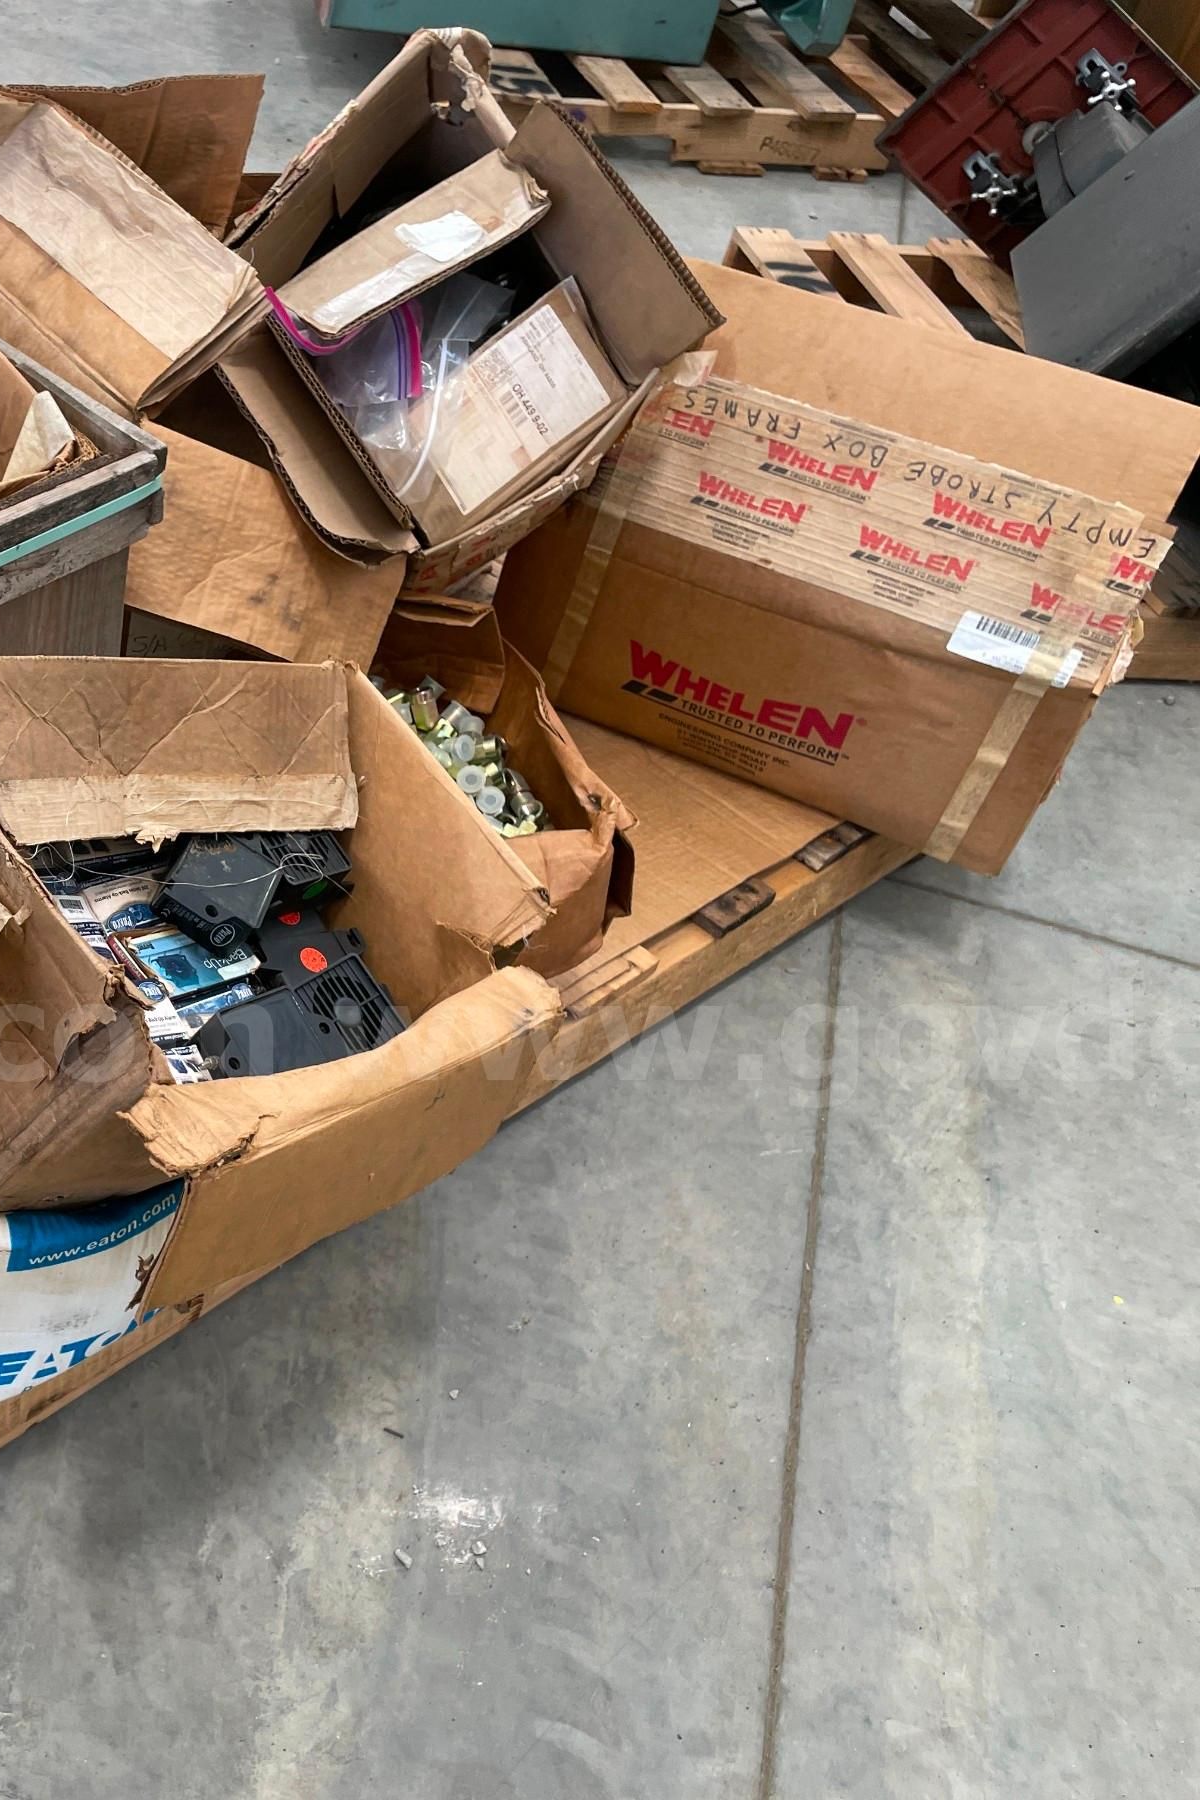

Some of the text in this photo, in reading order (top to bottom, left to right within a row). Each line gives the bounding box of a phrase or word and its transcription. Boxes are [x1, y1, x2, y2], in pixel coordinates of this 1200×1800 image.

[512, 383, 526, 399] OH
[684, 389, 801, 439] FRAMES
[767, 438, 879, 492] WHELEN
[822, 432, 889, 468] BOX
[698, 469, 806, 524] WHELEN
[789, 468, 821, 487] TRUSTED
[903, 461, 1023, 508] STROBE
[932, 488, 1052, 550] WHELEN
[1037, 498, 1157, 559] EMPTY
[859, 523, 976, 582] WHELEN
[1002, 540, 1040, 559] PERFORM
[629, 639, 855, 749] WHELEN
[681, 699, 743, 729] TRUSTED
[747, 723, 766, 737] TO
[767, 731, 840, 762] PERFORM
[29, 1190, 178, 1267] www.eaton.com
